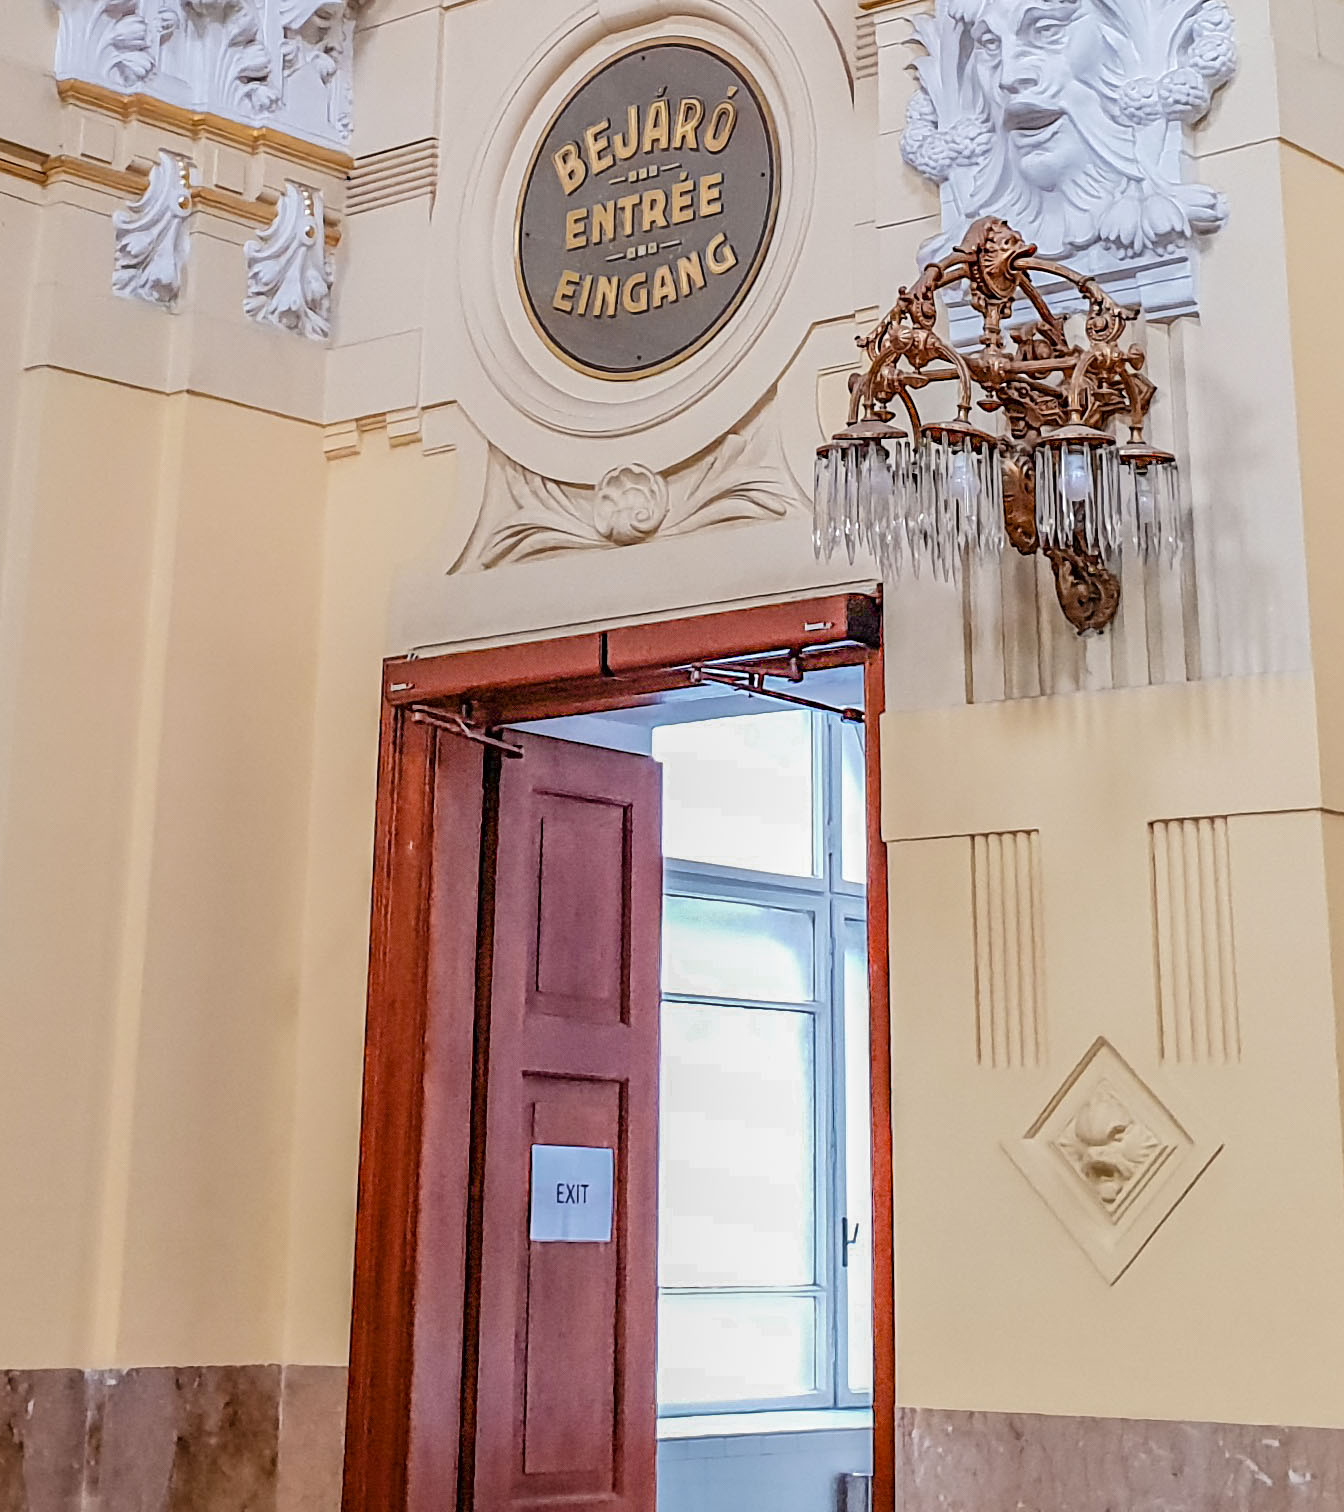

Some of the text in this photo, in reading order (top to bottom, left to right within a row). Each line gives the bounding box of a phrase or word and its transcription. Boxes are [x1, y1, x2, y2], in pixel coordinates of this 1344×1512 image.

[553, 86, 737, 196] BEJÁRÓ
[565, 172, 723, 250] ENTRÉE
[552, 233, 737, 317] EINGANG
[556, 1183, 589, 1204] EXIT
